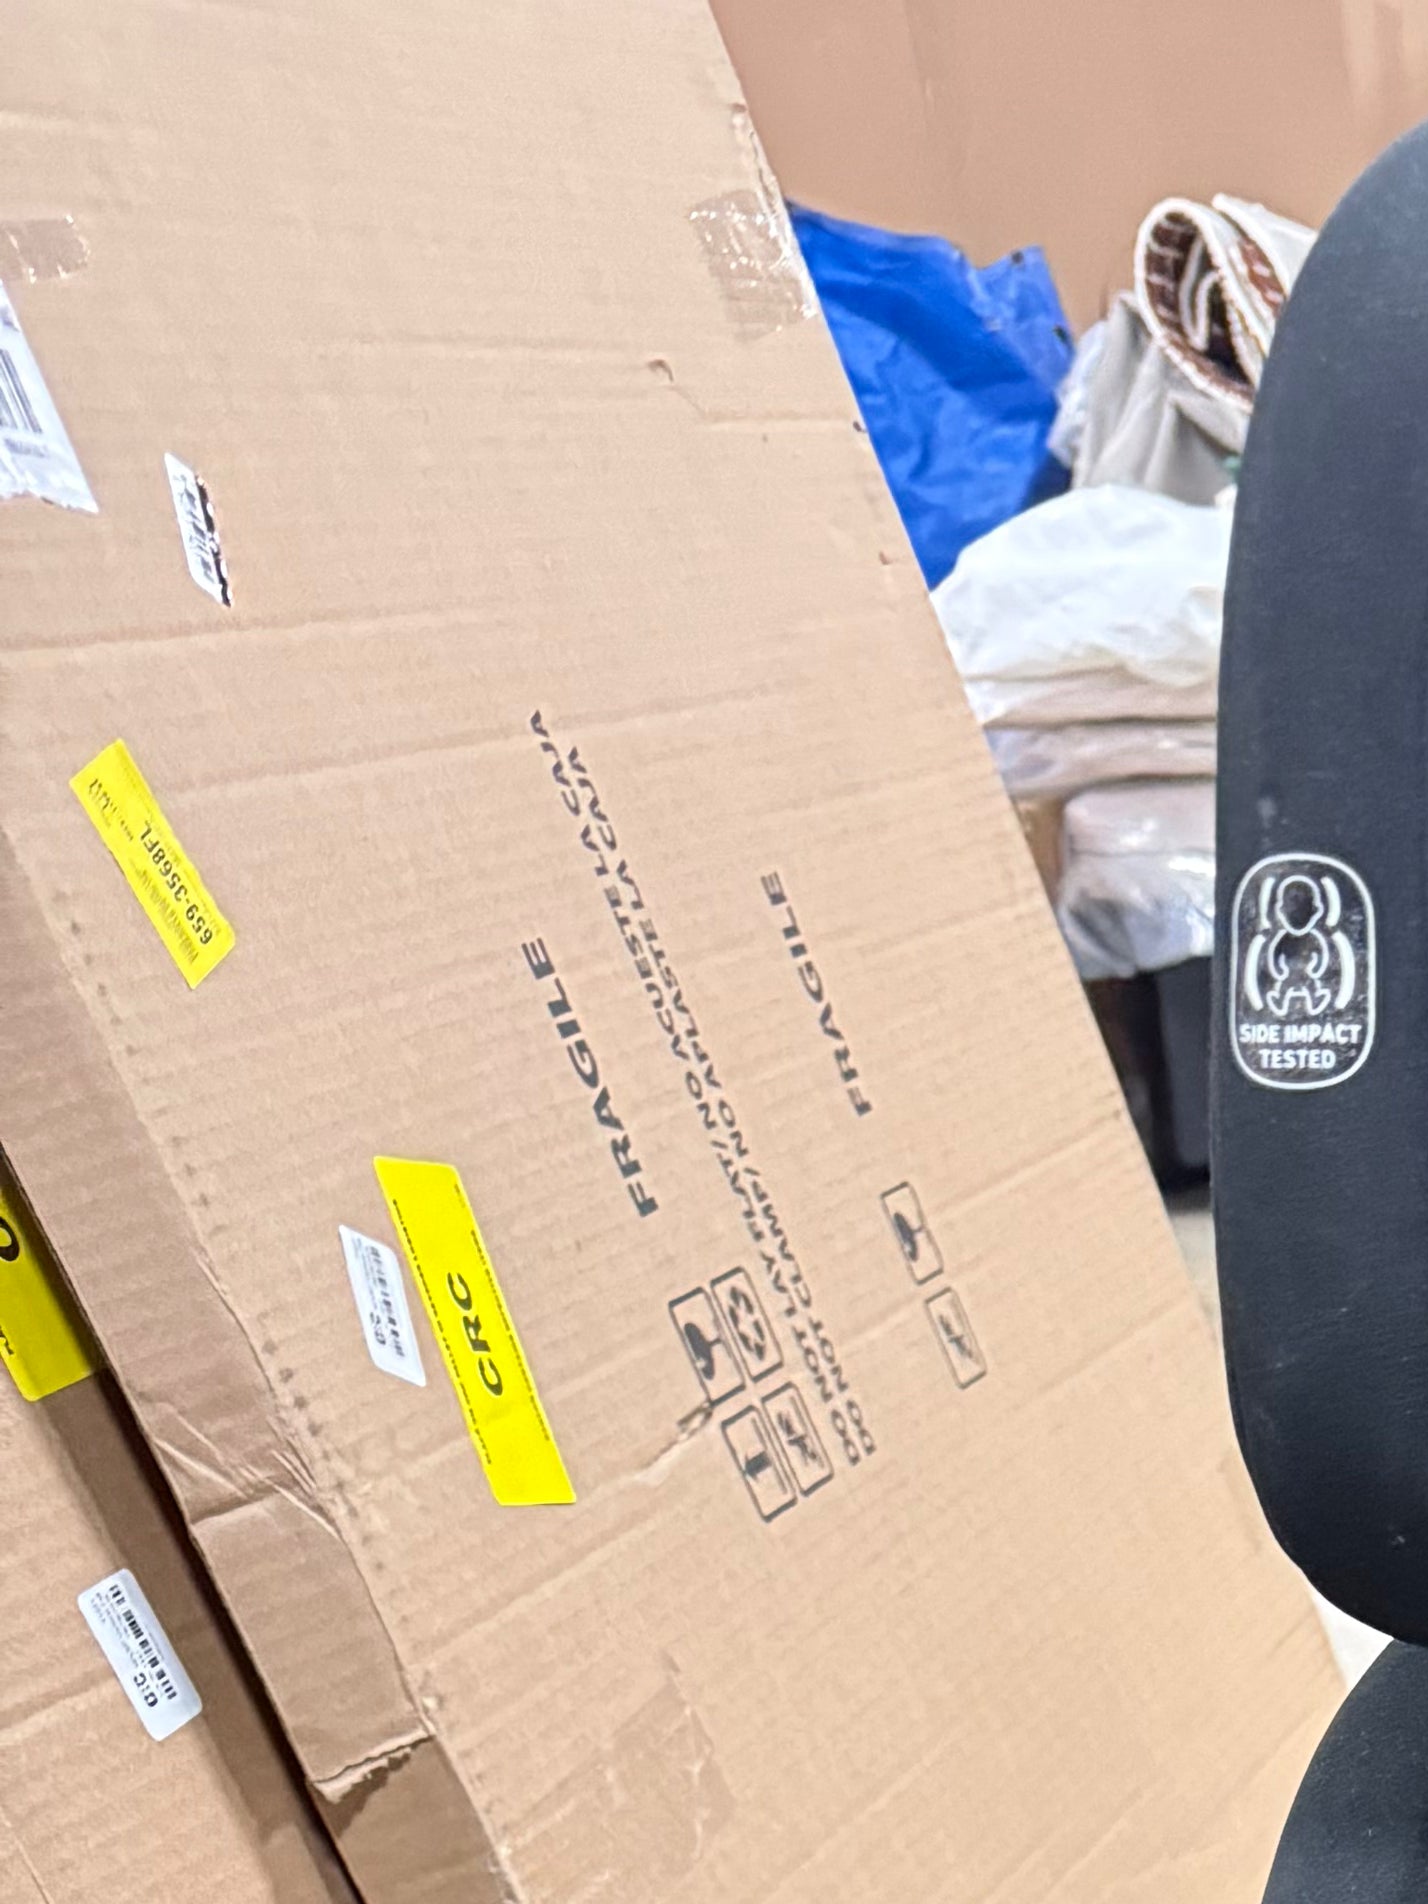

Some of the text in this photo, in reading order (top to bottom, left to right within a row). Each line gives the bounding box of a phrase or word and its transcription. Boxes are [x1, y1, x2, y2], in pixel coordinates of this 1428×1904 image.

[139, 820, 213, 944] 659-3568FL
[521, 937, 657, 1215] FRAGILE
[761, 871, 871, 1114] FRAGILE
[1239, 1023, 1362, 1043] SIDE IMPACT
[1259, 1048, 1336, 1069] TESTED
[529, 710, 860, 1464] DO NOT LAY FLAT/ NO ACUESTE LA CAJA
[568, 746, 875, 1454] DO NOT CLAMP/ NO APLASTE LA CAJA
[447, 1272, 503, 1396] CRC
